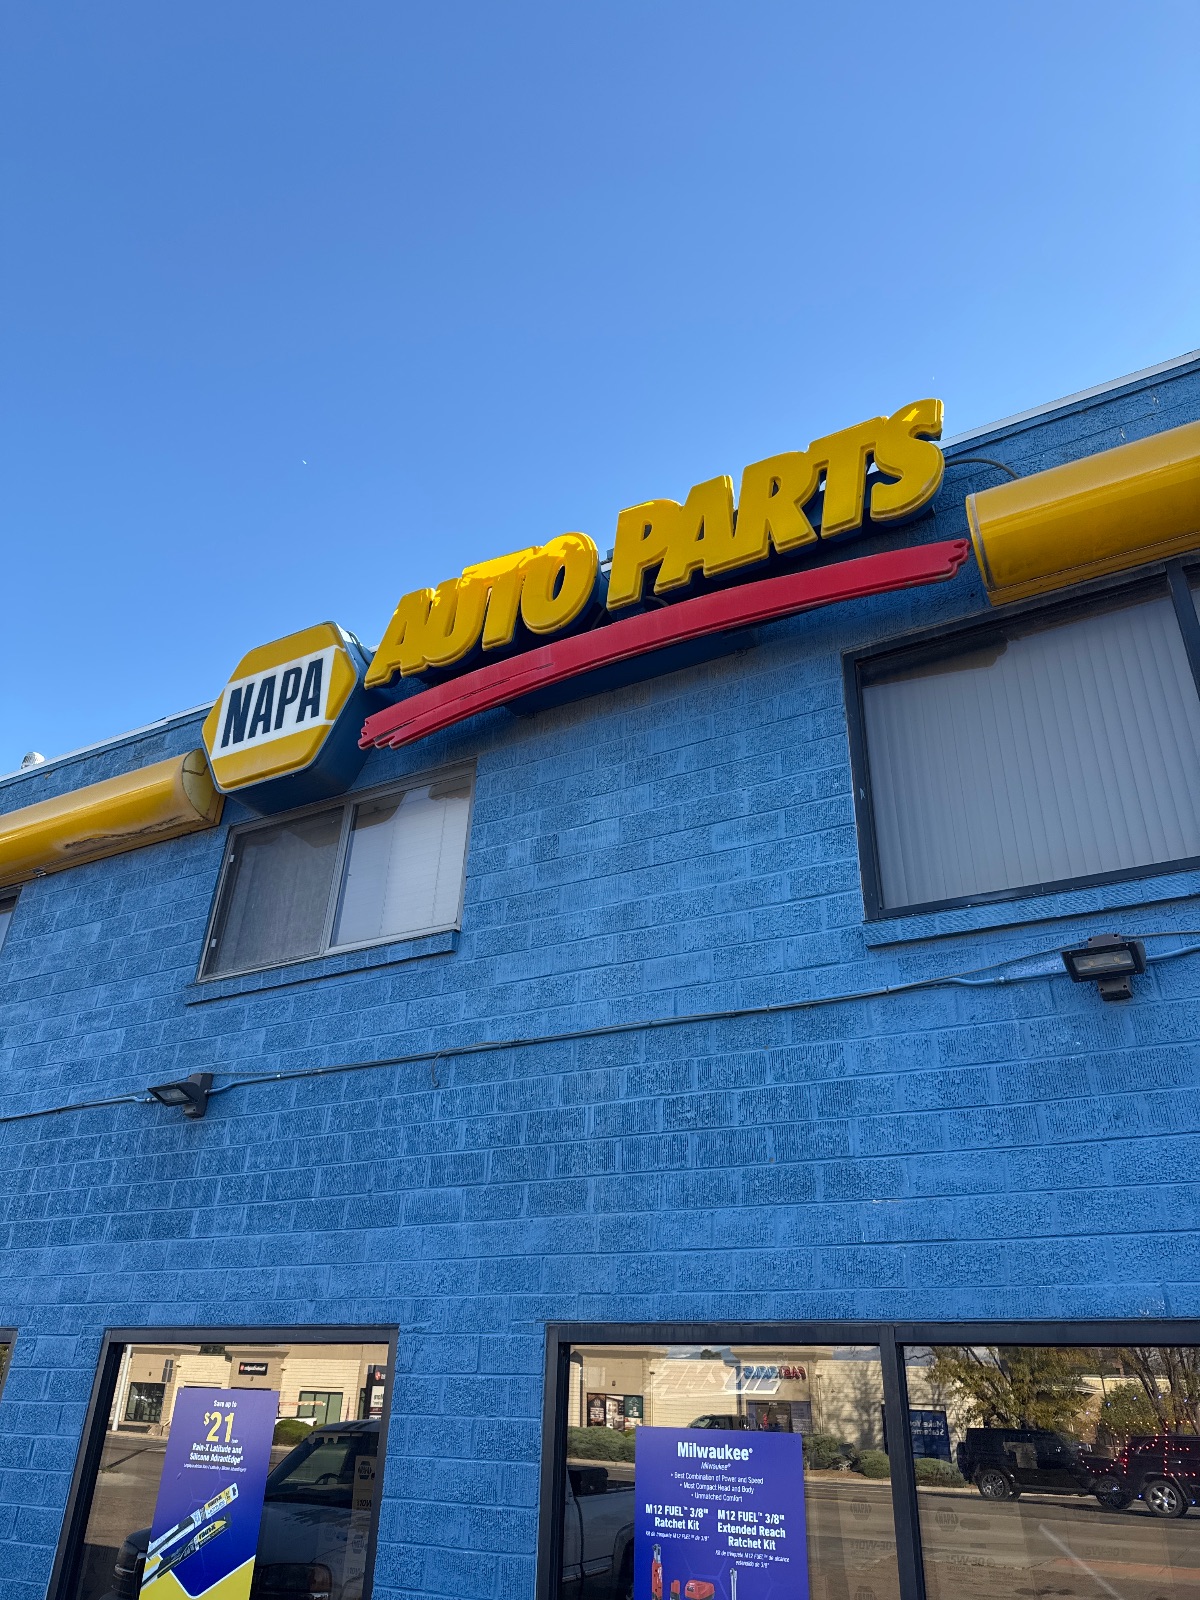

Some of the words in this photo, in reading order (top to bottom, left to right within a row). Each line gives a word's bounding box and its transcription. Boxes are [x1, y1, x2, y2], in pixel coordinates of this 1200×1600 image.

[364, 530, 600, 690] AUTO
[606, 397, 945, 611] PARTS
[220, 657, 324, 749] NAPA
[213, 1399, 225, 1408] Save
[203, 1411, 235, 1443] $21
[192, 1442, 210, 1452] Rain-X
[210, 1444, 231, 1453] Latitude
[231, 1446, 243, 1454] and
[189, 1452, 210, 1462] Silicone
[674, 1471, 685, 1479] Best
[685, 1472, 715, 1481] Combination
[721, 1475, 737, 1483] Power
[747, 1477, 764, 1485] Speed
[683, 1481, 696, 1490] Most
[695, 1482, 718, 1492] Compact
[717, 1484, 731, 1492] Head
[731, 1485, 741, 1493] and
[741, 1486, 755, 1495] Body
[694, 1491, 722, 1501] Unmatched
[722, 1493, 743, 1502] Comfort
[645, 1503, 663, 1515] M12
[717, 1509, 736, 1521] M12
[654, 1516, 686, 1530] Ratchet
[687, 1519, 700, 1531] Kit
[717, 1522, 757, 1536] Extended
[758, 1525, 786, 1539] Reach
[728, 1535, 762, 1549] Ratchet
[763, 1538, 776, 1550] Kit
